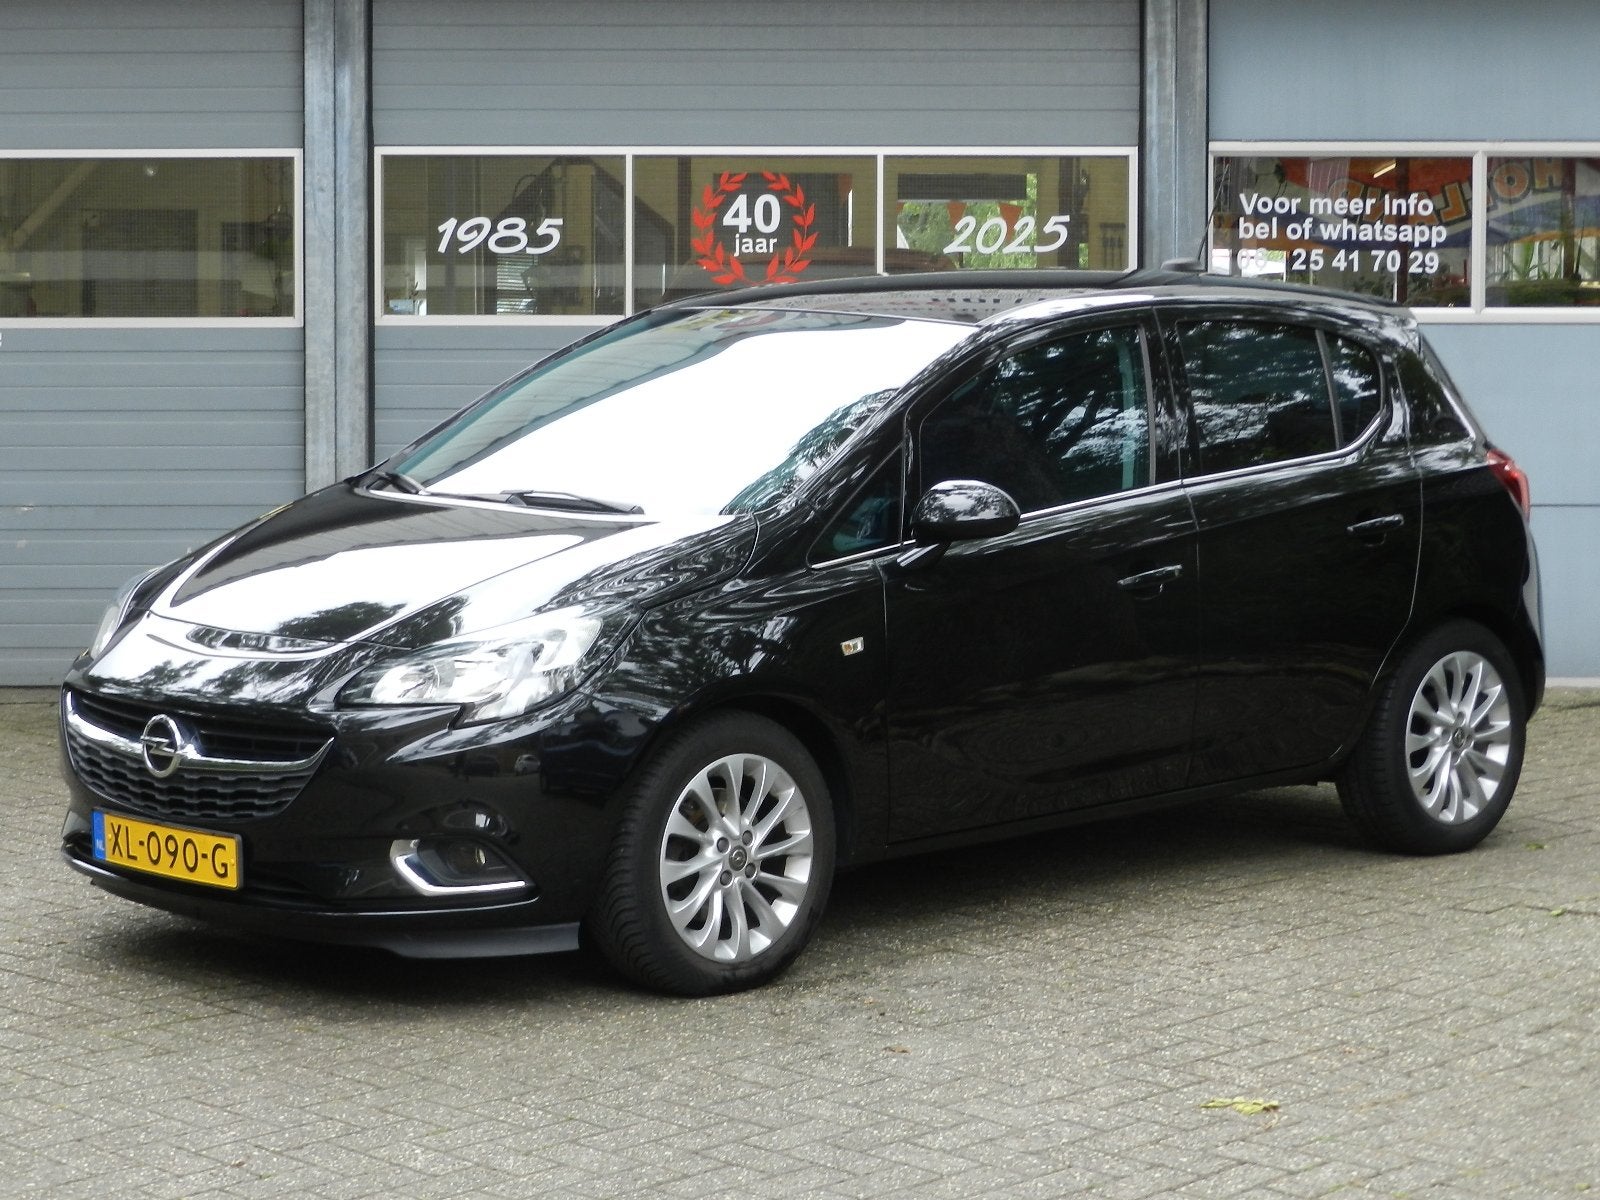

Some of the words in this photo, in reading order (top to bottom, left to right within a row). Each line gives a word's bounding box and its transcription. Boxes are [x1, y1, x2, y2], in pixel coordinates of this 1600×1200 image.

[722, 193, 781, 233] 40
[1239, 193, 1301, 215] Voor
[1309, 197, 1376, 215] meer
[437, 216, 564, 254] 1985
[733, 233, 778, 257] jaar
[943, 215, 1071, 254] 2025
[1239, 217, 1278, 239] bel
[1286, 217, 1313, 240] of
[1320, 217, 1447, 248] whatsapp
[1292, 249, 1324, 271] 25
[1332, 249, 1359, 272] 41
[1371, 250, 1401, 272] 70
[1408, 251, 1439, 274] 29
[110, 822, 229, 878] XL-090-G
